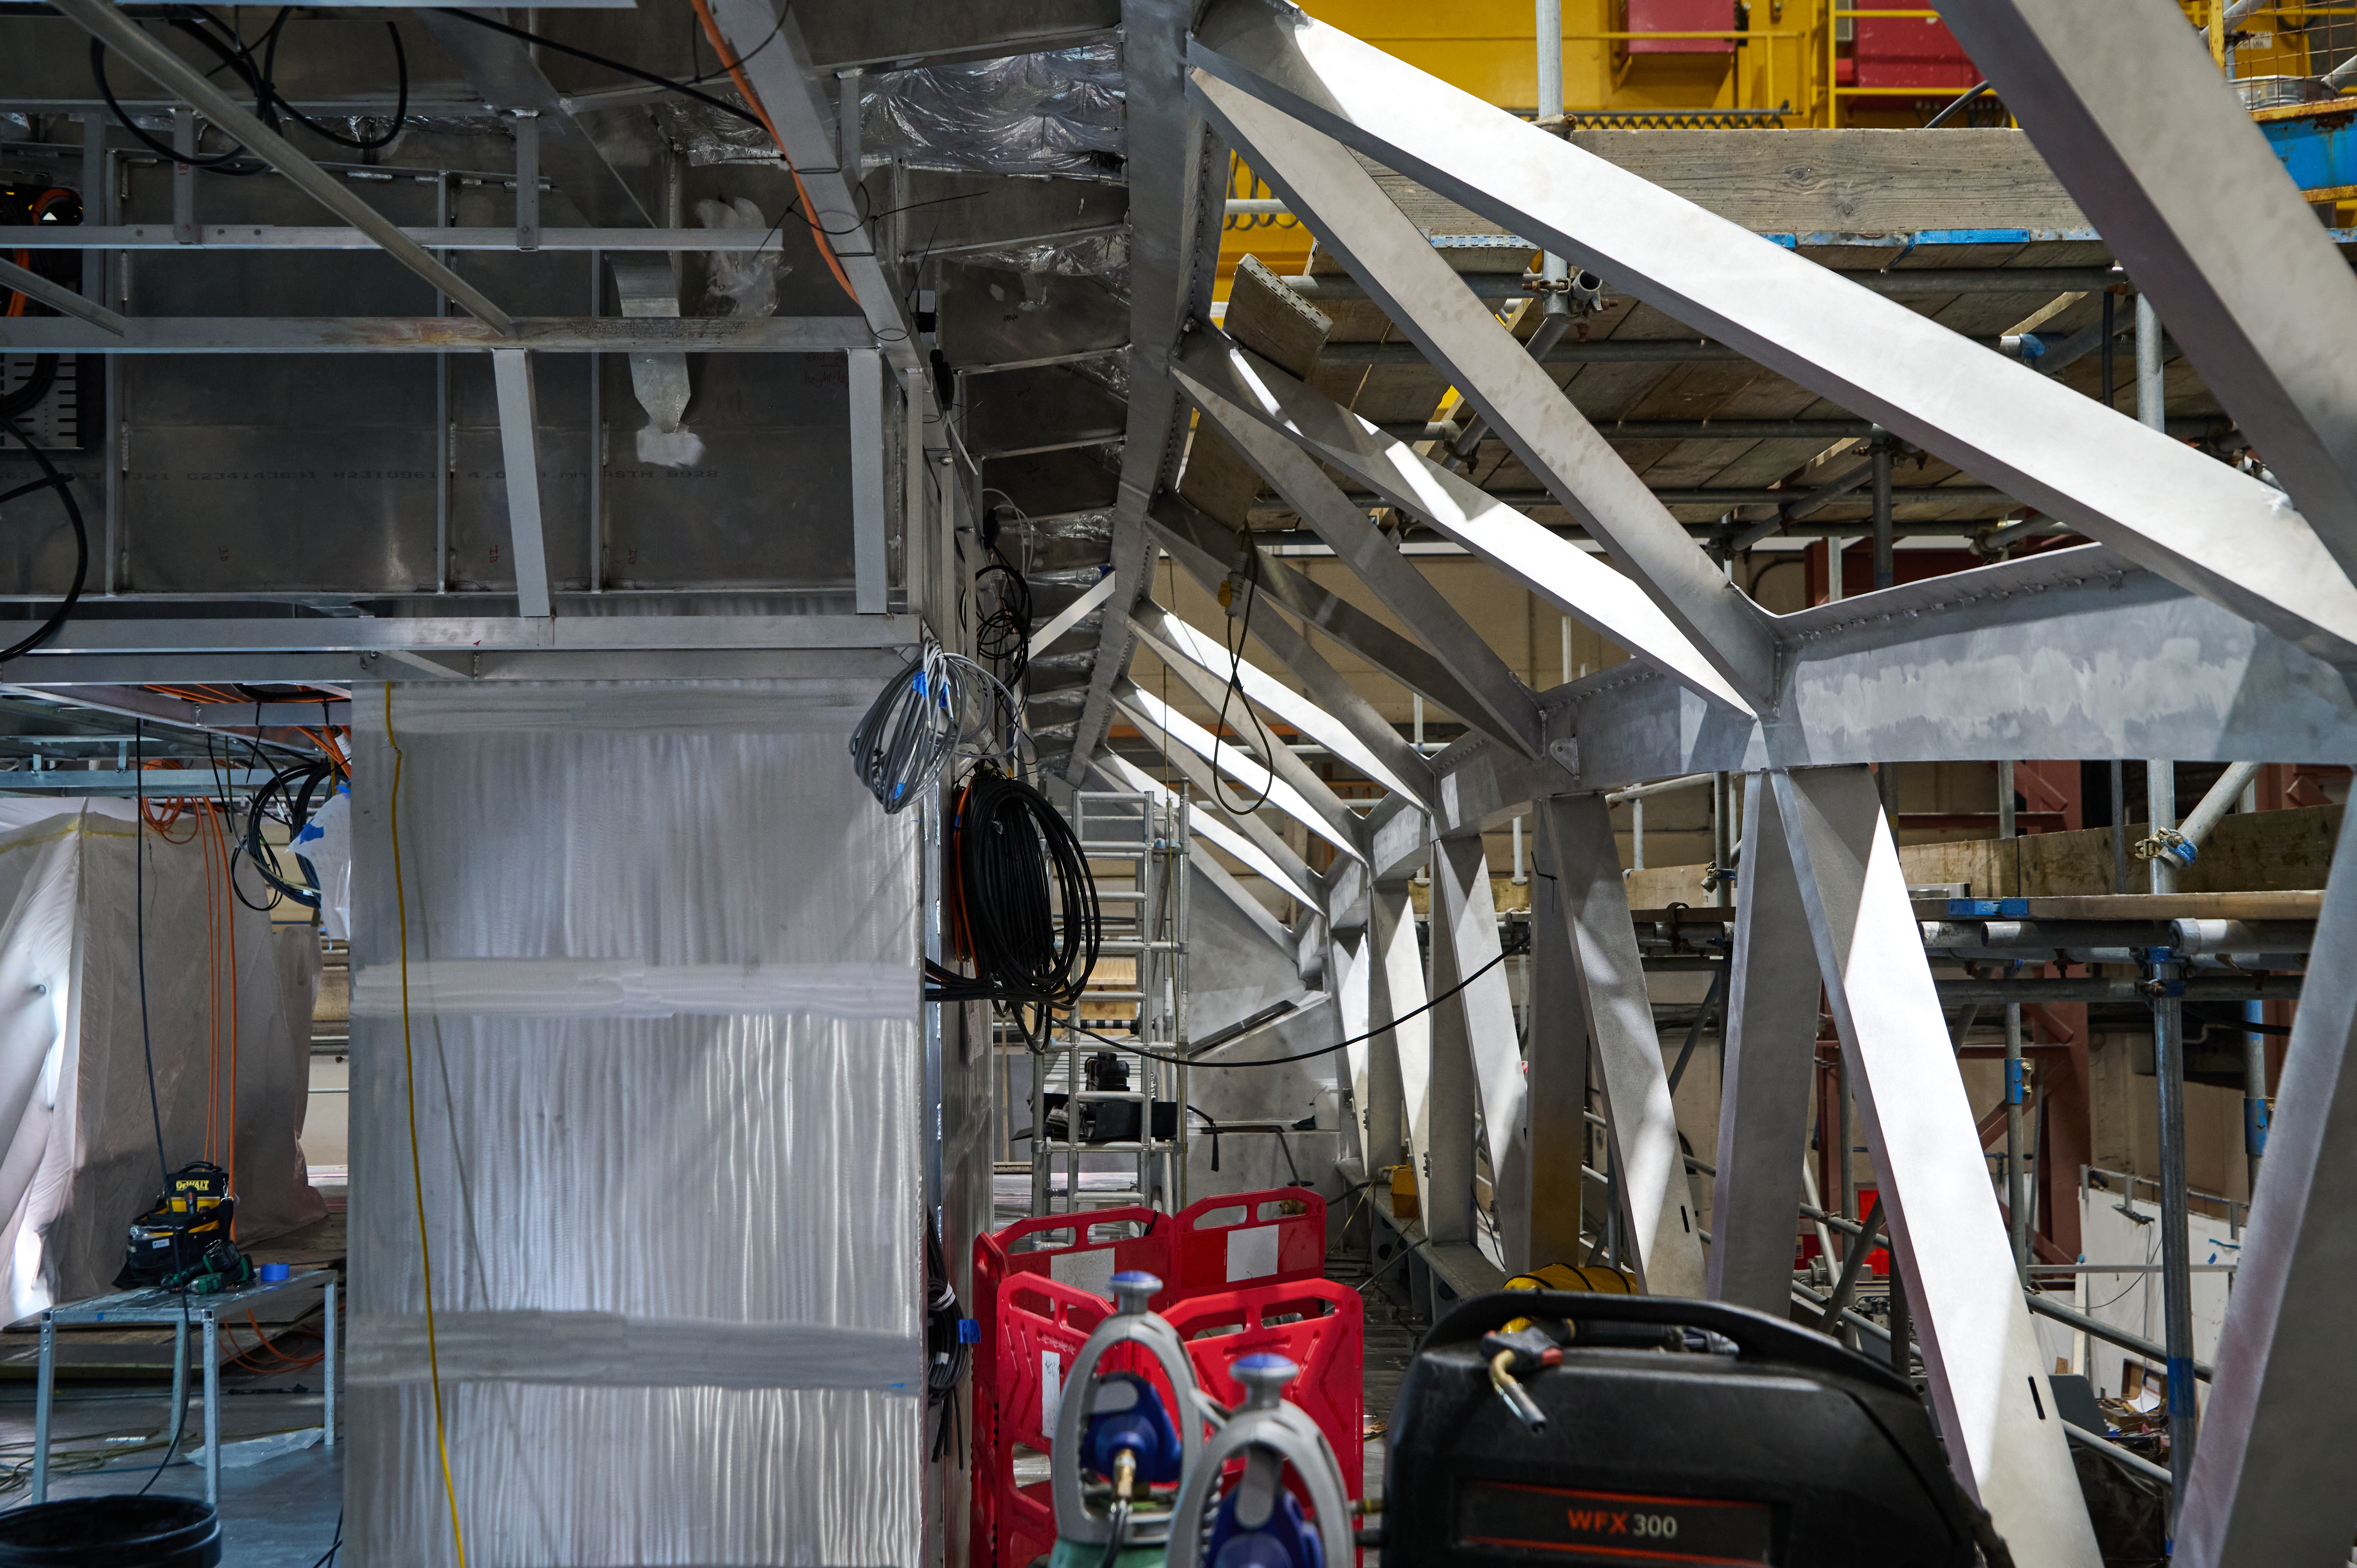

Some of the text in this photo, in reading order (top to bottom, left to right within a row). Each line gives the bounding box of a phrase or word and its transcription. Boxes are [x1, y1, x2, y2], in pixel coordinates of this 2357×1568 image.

[1262, 274, 1285, 293] ZIEGLER
[667, 470, 719, 479] B928
[1567, 1508, 1678, 1539] WFX 300
